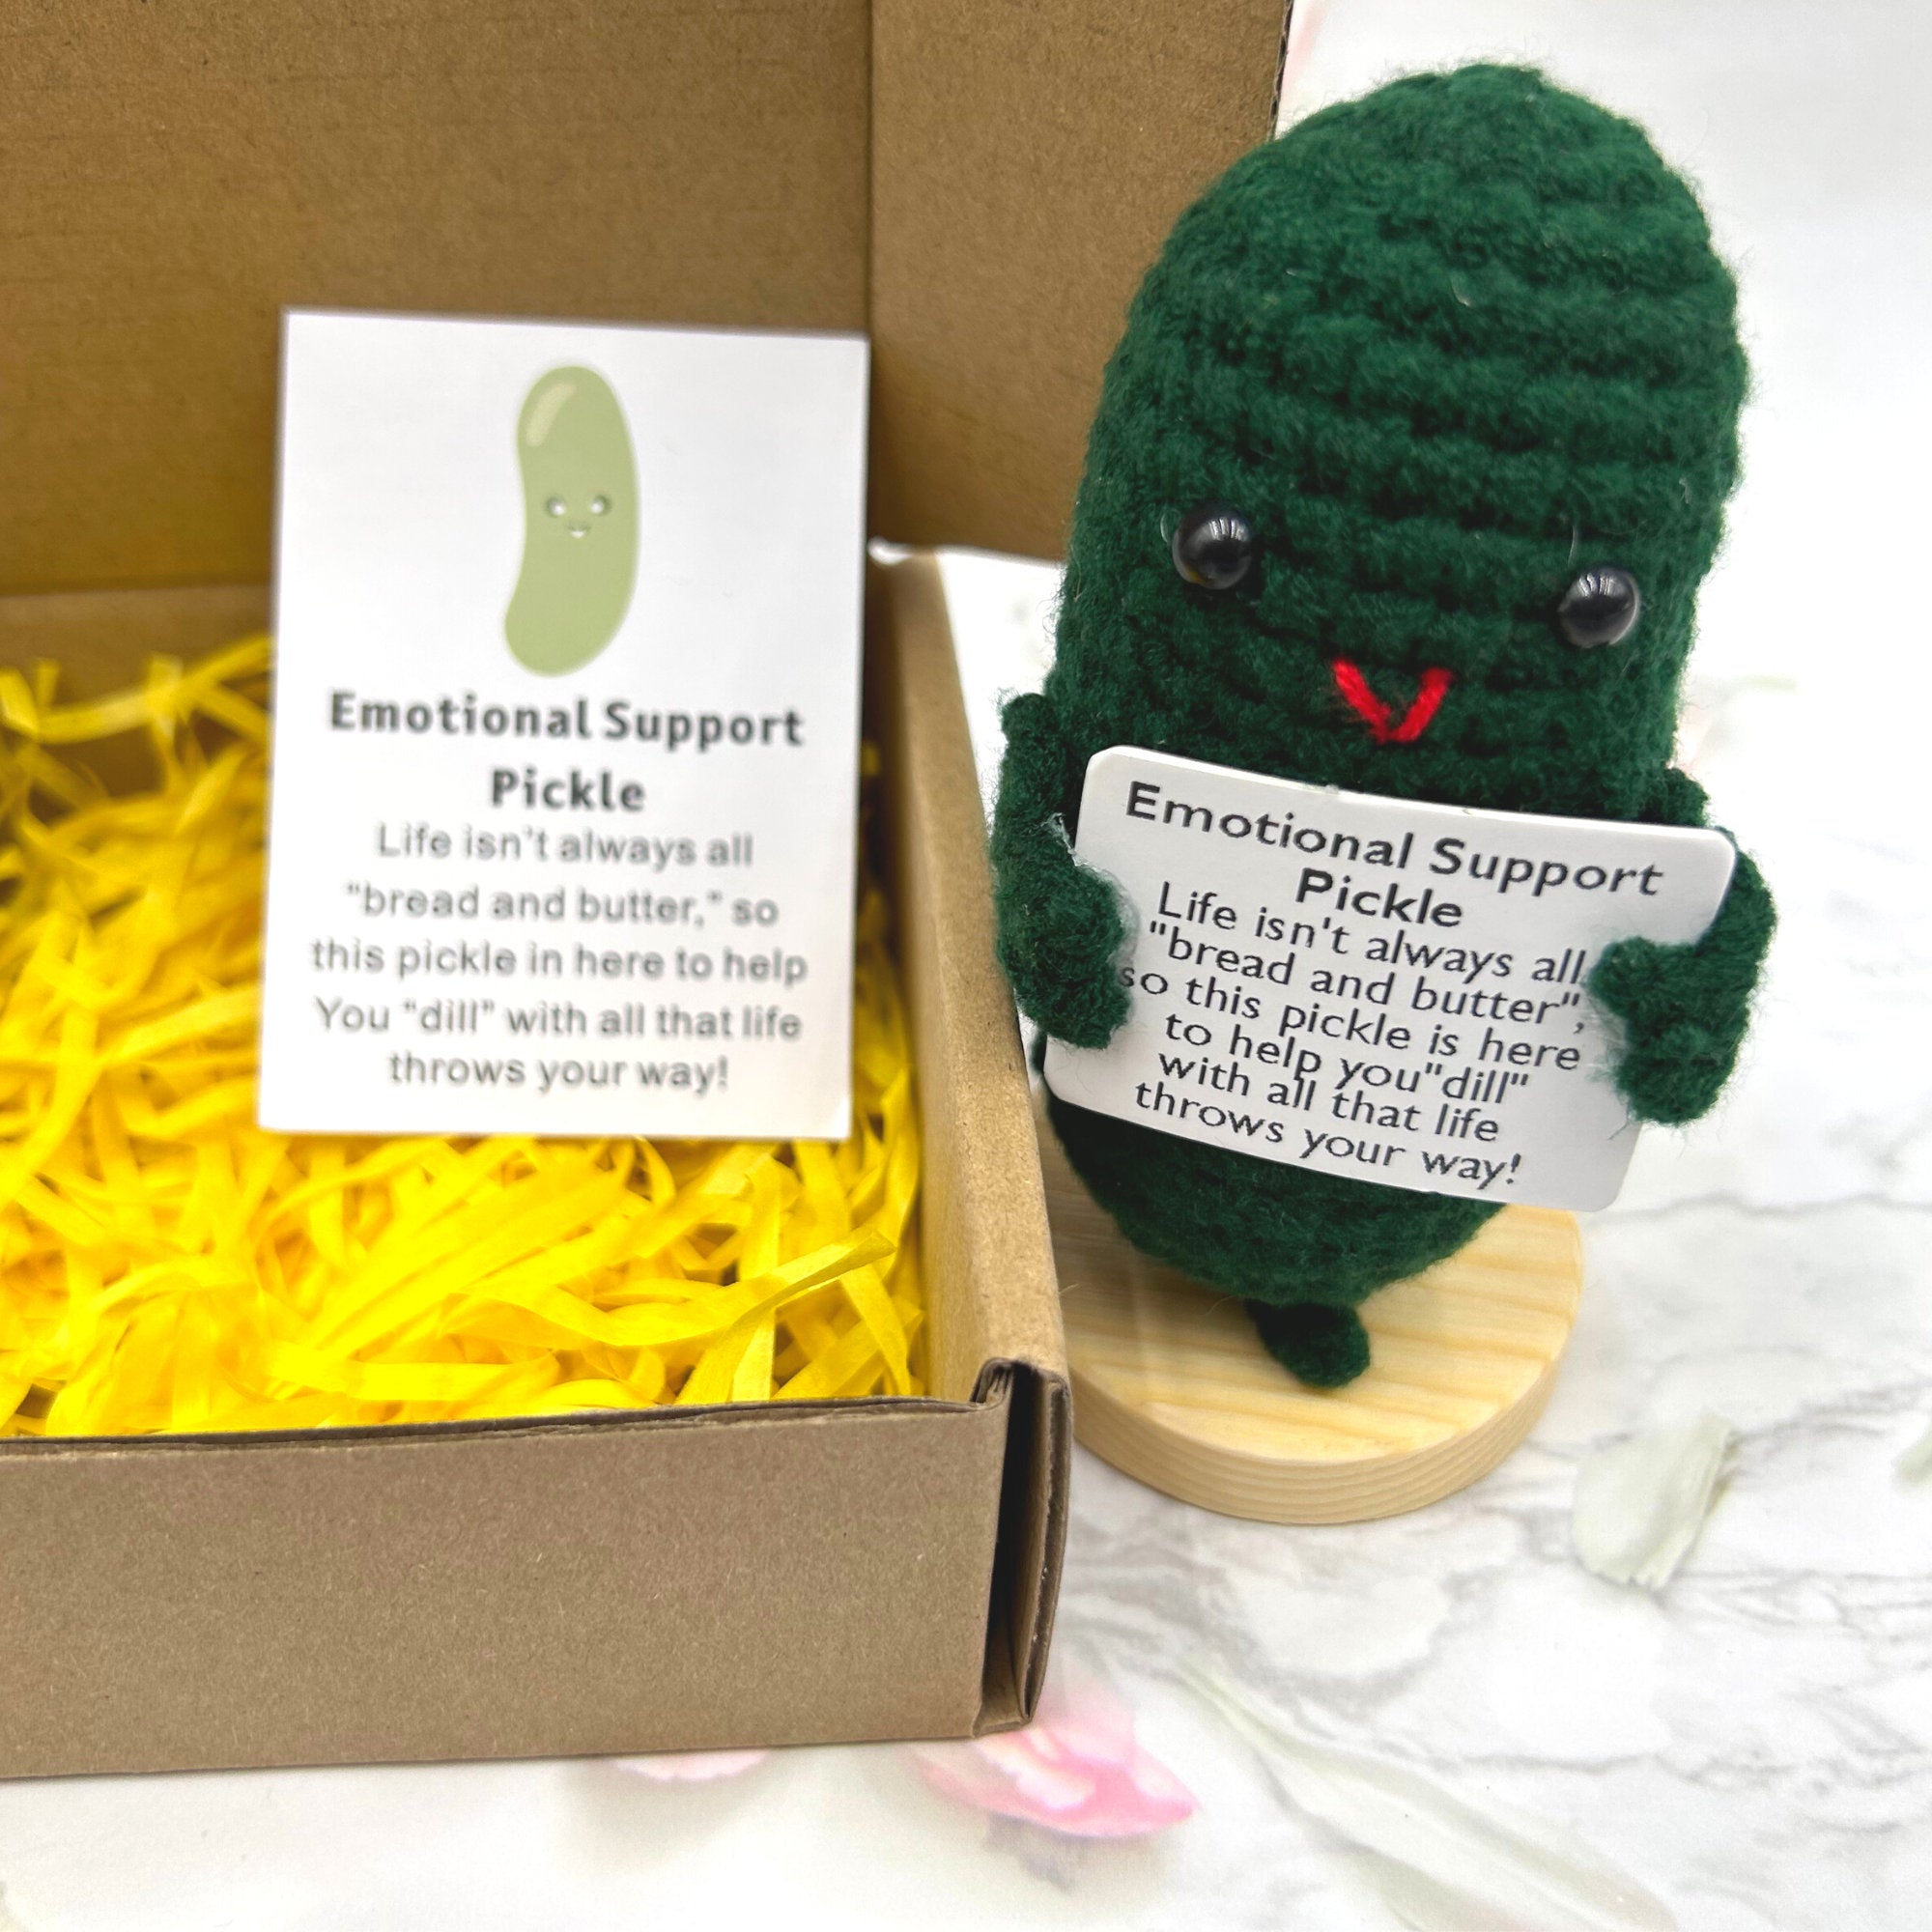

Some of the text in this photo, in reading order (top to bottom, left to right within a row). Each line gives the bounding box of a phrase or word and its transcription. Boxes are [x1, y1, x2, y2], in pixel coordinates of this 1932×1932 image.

[328, 689, 805, 753] Emotional Support
[489, 765, 646, 811] Pickle
[377, 823, 753, 872] Life isn't always all
[1126, 781, 1663, 896] Emotional Support
[492, 887, 565, 922] and
[731, 898, 780, 927] so
[1295, 867, 1463, 928] Pickle
[311, 938, 809, 988] this pickle in here to help
[1158, 881, 1586, 984] Life isn't always all
[1119, 966, 1580, 1070] so this pickle is here
[1310, 970, 1396, 1006] and
[316, 997, 389, 1033] You
[505, 1001, 587, 1037] with
[597, 1003, 645, 1037] all
[655, 1004, 733, 1040] that
[742, 1005, 803, 1041] life
[1166, 1013, 1212, 1046] to
[1229, 1024, 1321, 1075] help
[389, 1051, 728, 1098] throws your way!
[1158, 1053, 1498, 1142] with all that life
[1136, 1082, 1521, 1190] throws your way!
